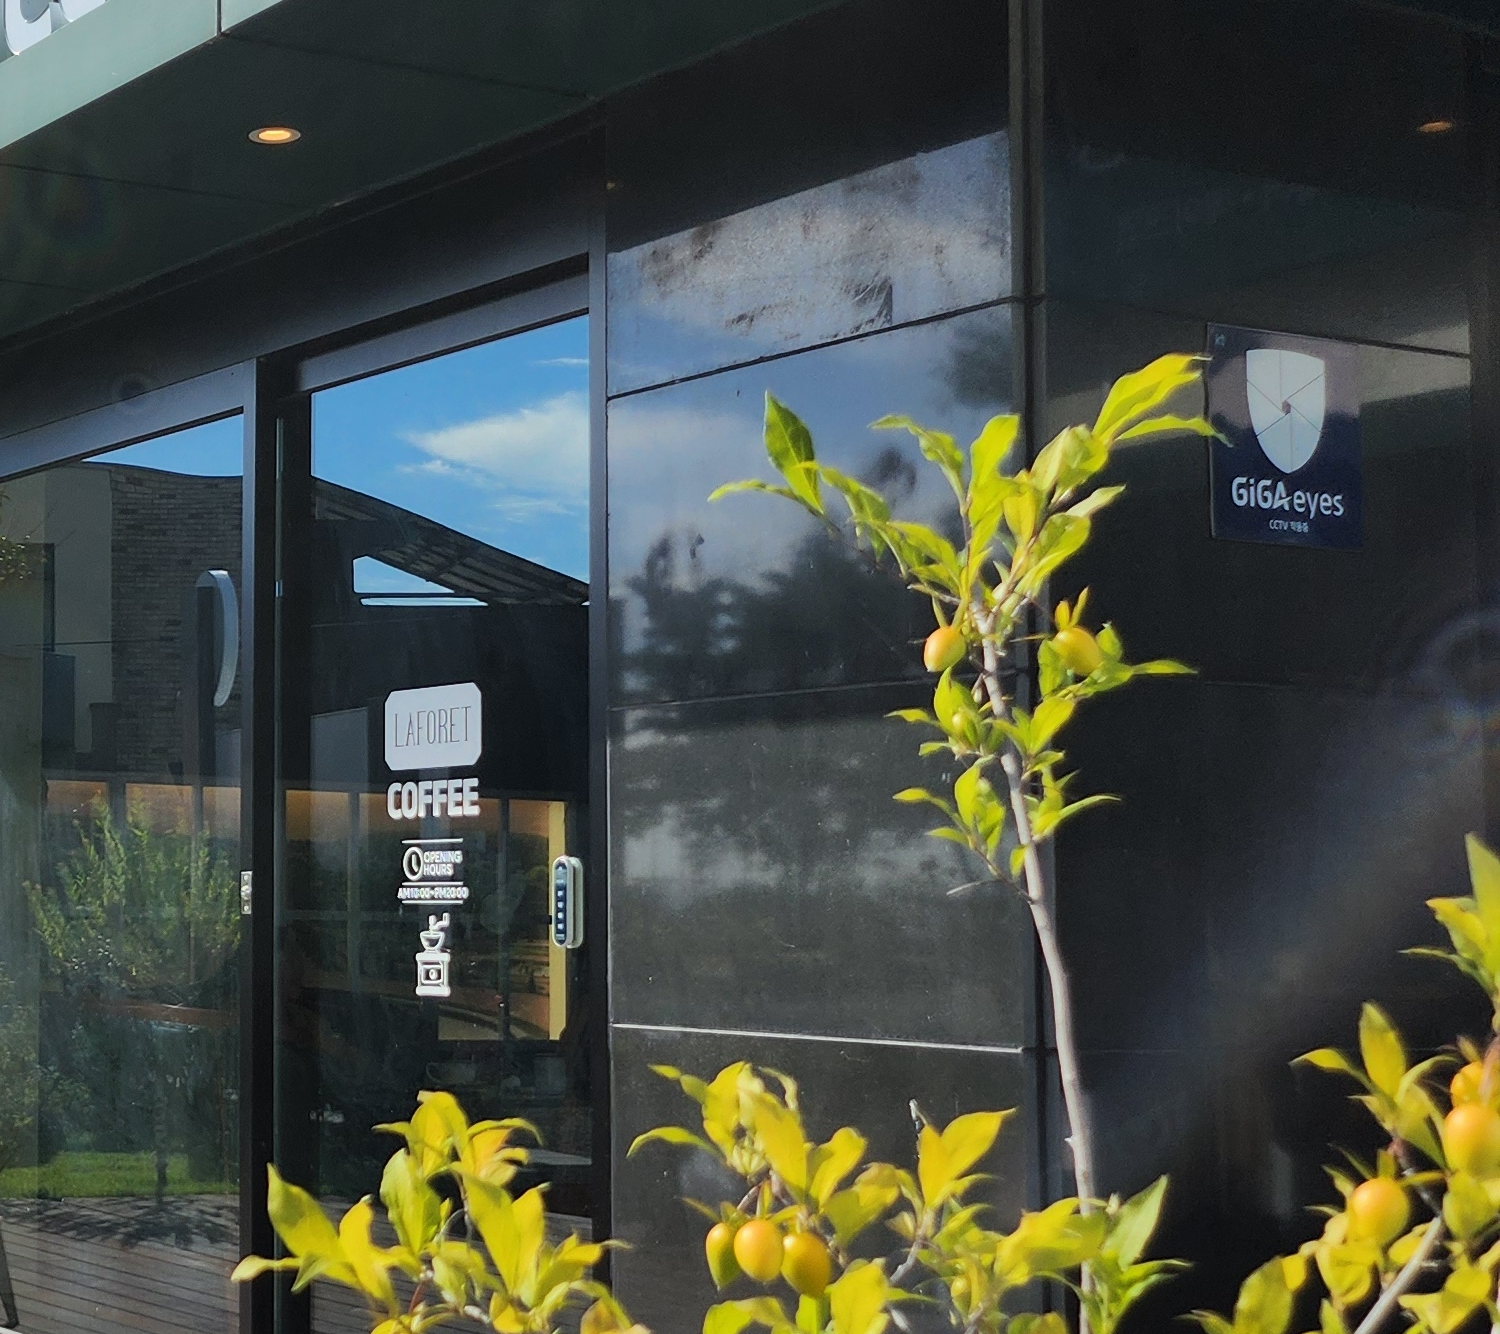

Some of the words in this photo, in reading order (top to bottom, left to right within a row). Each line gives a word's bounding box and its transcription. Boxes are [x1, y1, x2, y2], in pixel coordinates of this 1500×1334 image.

[1269, 519, 1289, 531] CCTV
[394, 705, 472, 748] LAFORET
[387, 778, 481, 819] COFFEE
[423, 850, 463, 863] OPENING
[423, 863, 454, 876] HOURS
